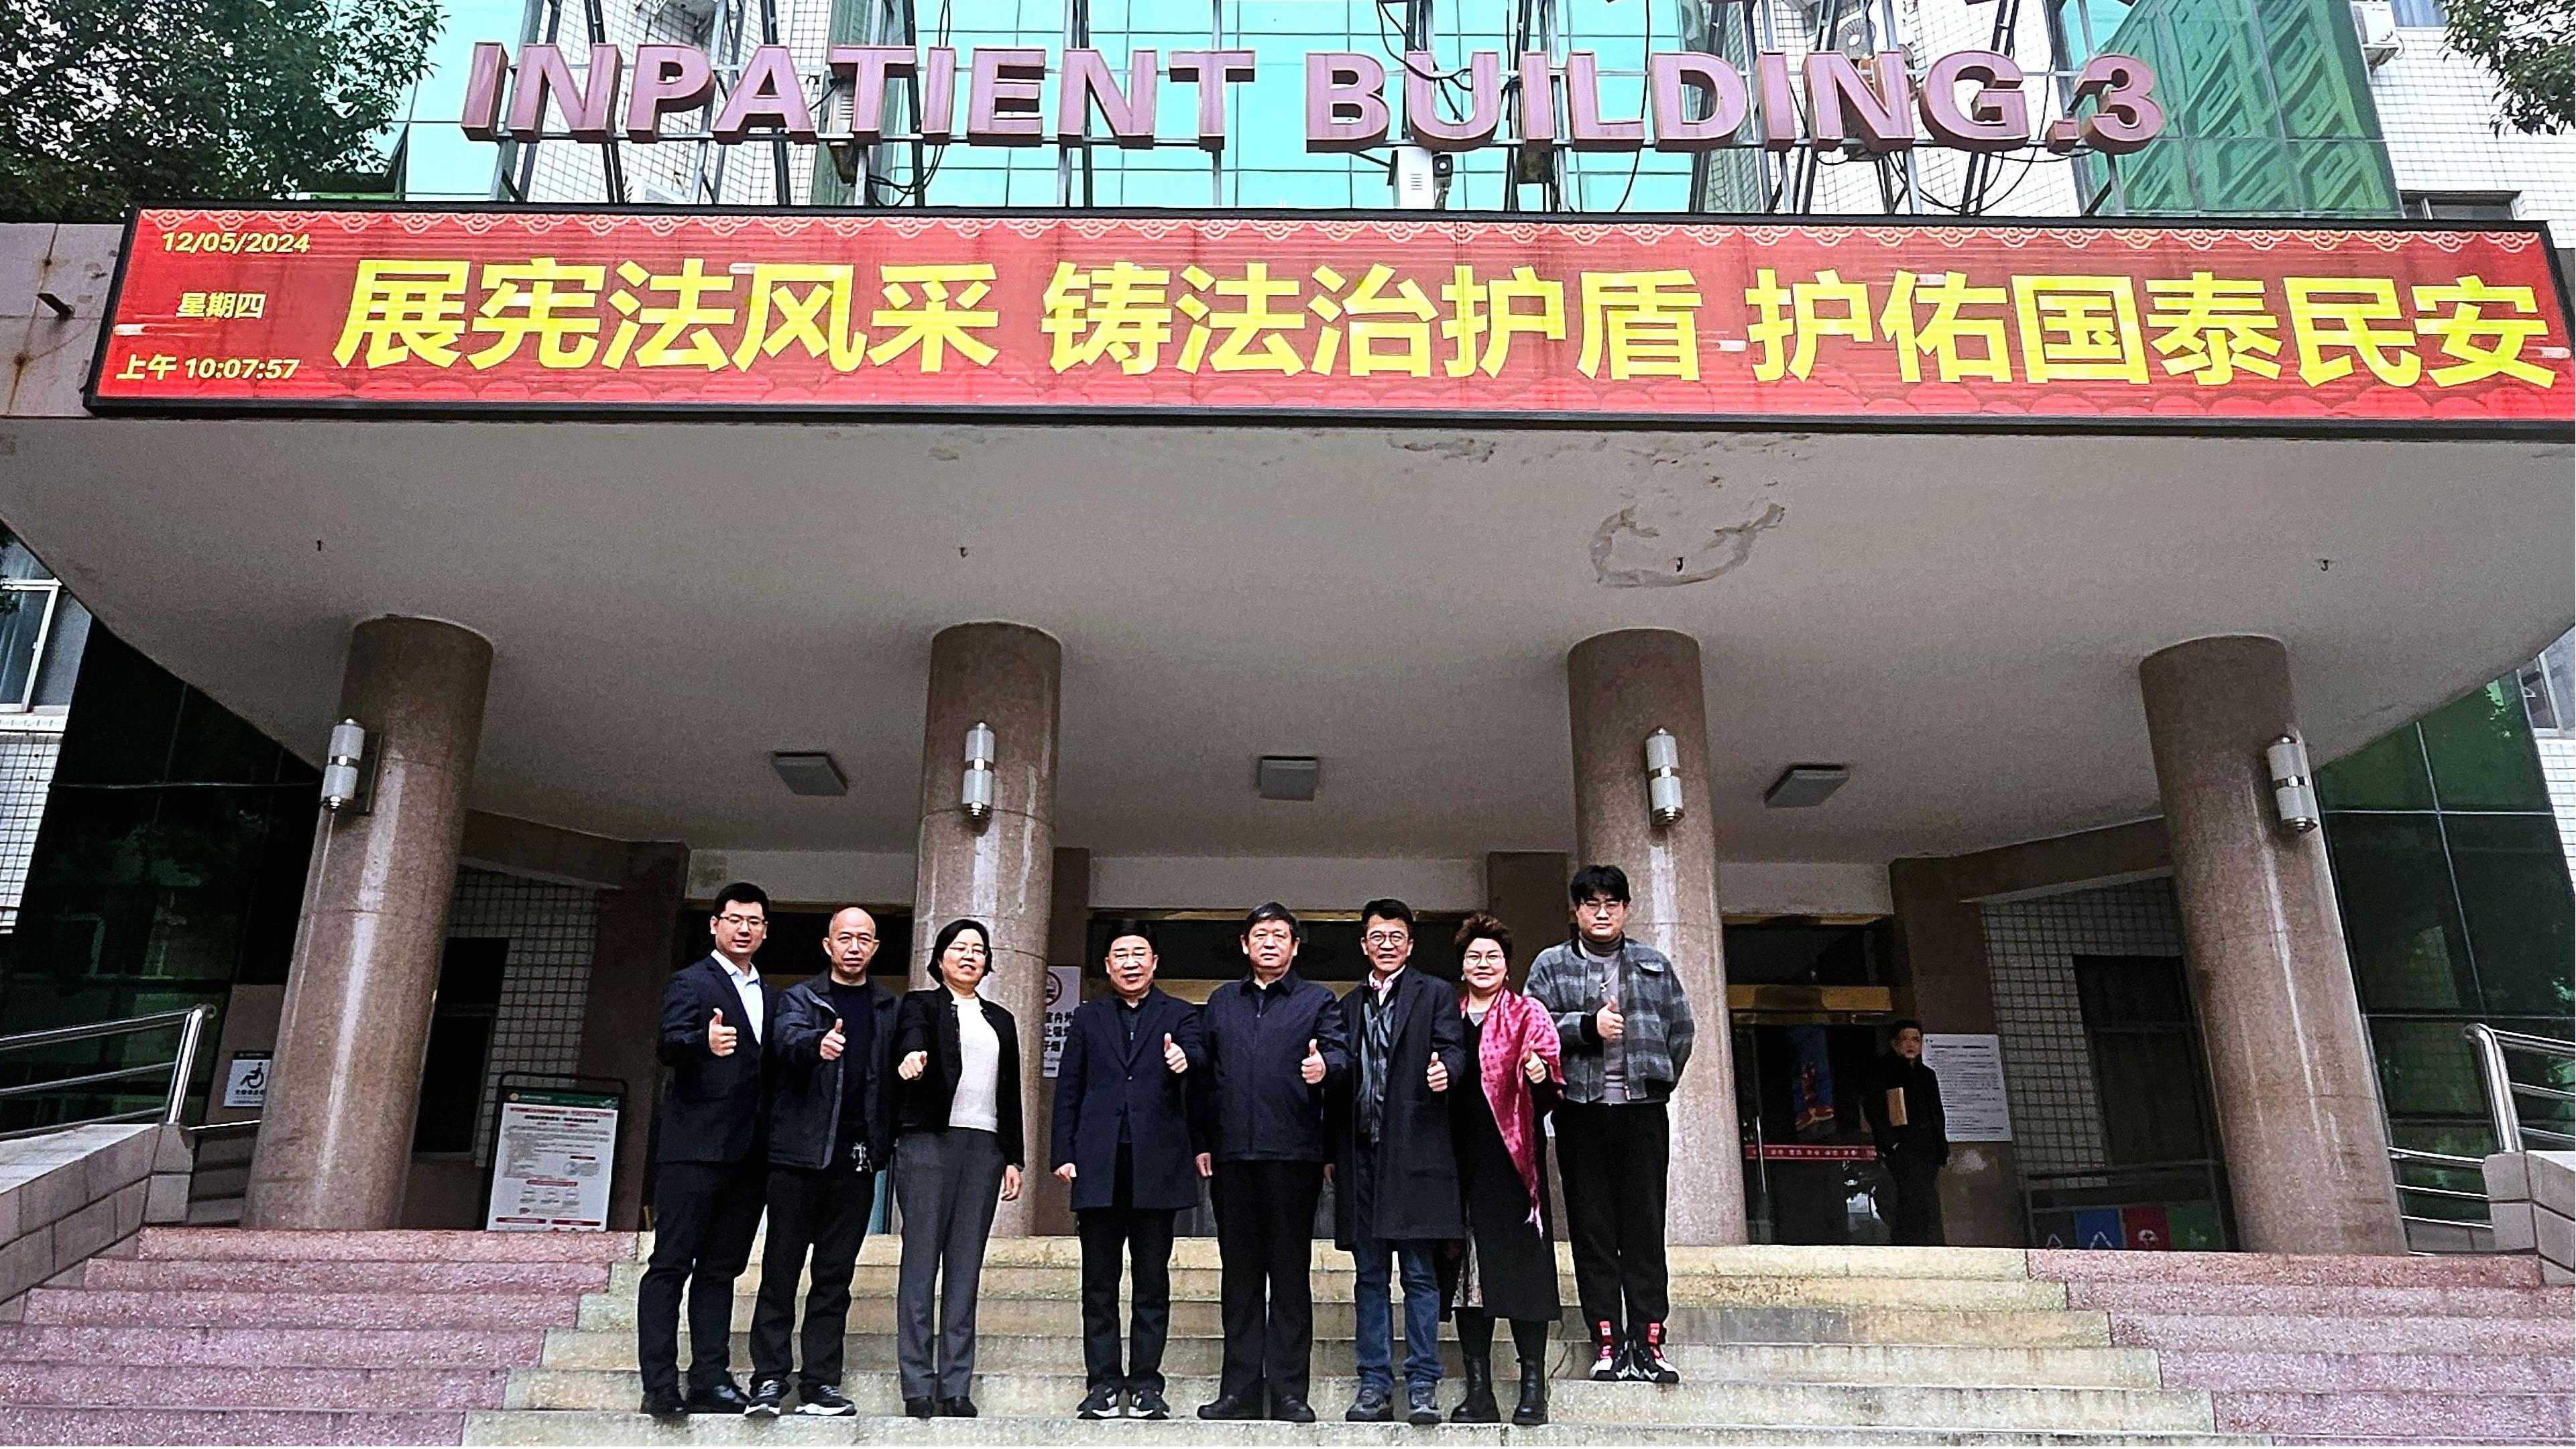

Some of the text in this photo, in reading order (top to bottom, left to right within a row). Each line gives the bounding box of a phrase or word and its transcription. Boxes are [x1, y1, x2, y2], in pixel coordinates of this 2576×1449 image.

[461, 42, 1255, 150] INPATIENT
[162, 232, 310, 253] 12/05/2024
[176, 291, 266, 319] 星期四
[331, 257, 2556, 388] 展宪法风采 铸法治护盾 护佑国泰民安
[115, 354, 300, 381] 上午 10:07:57
